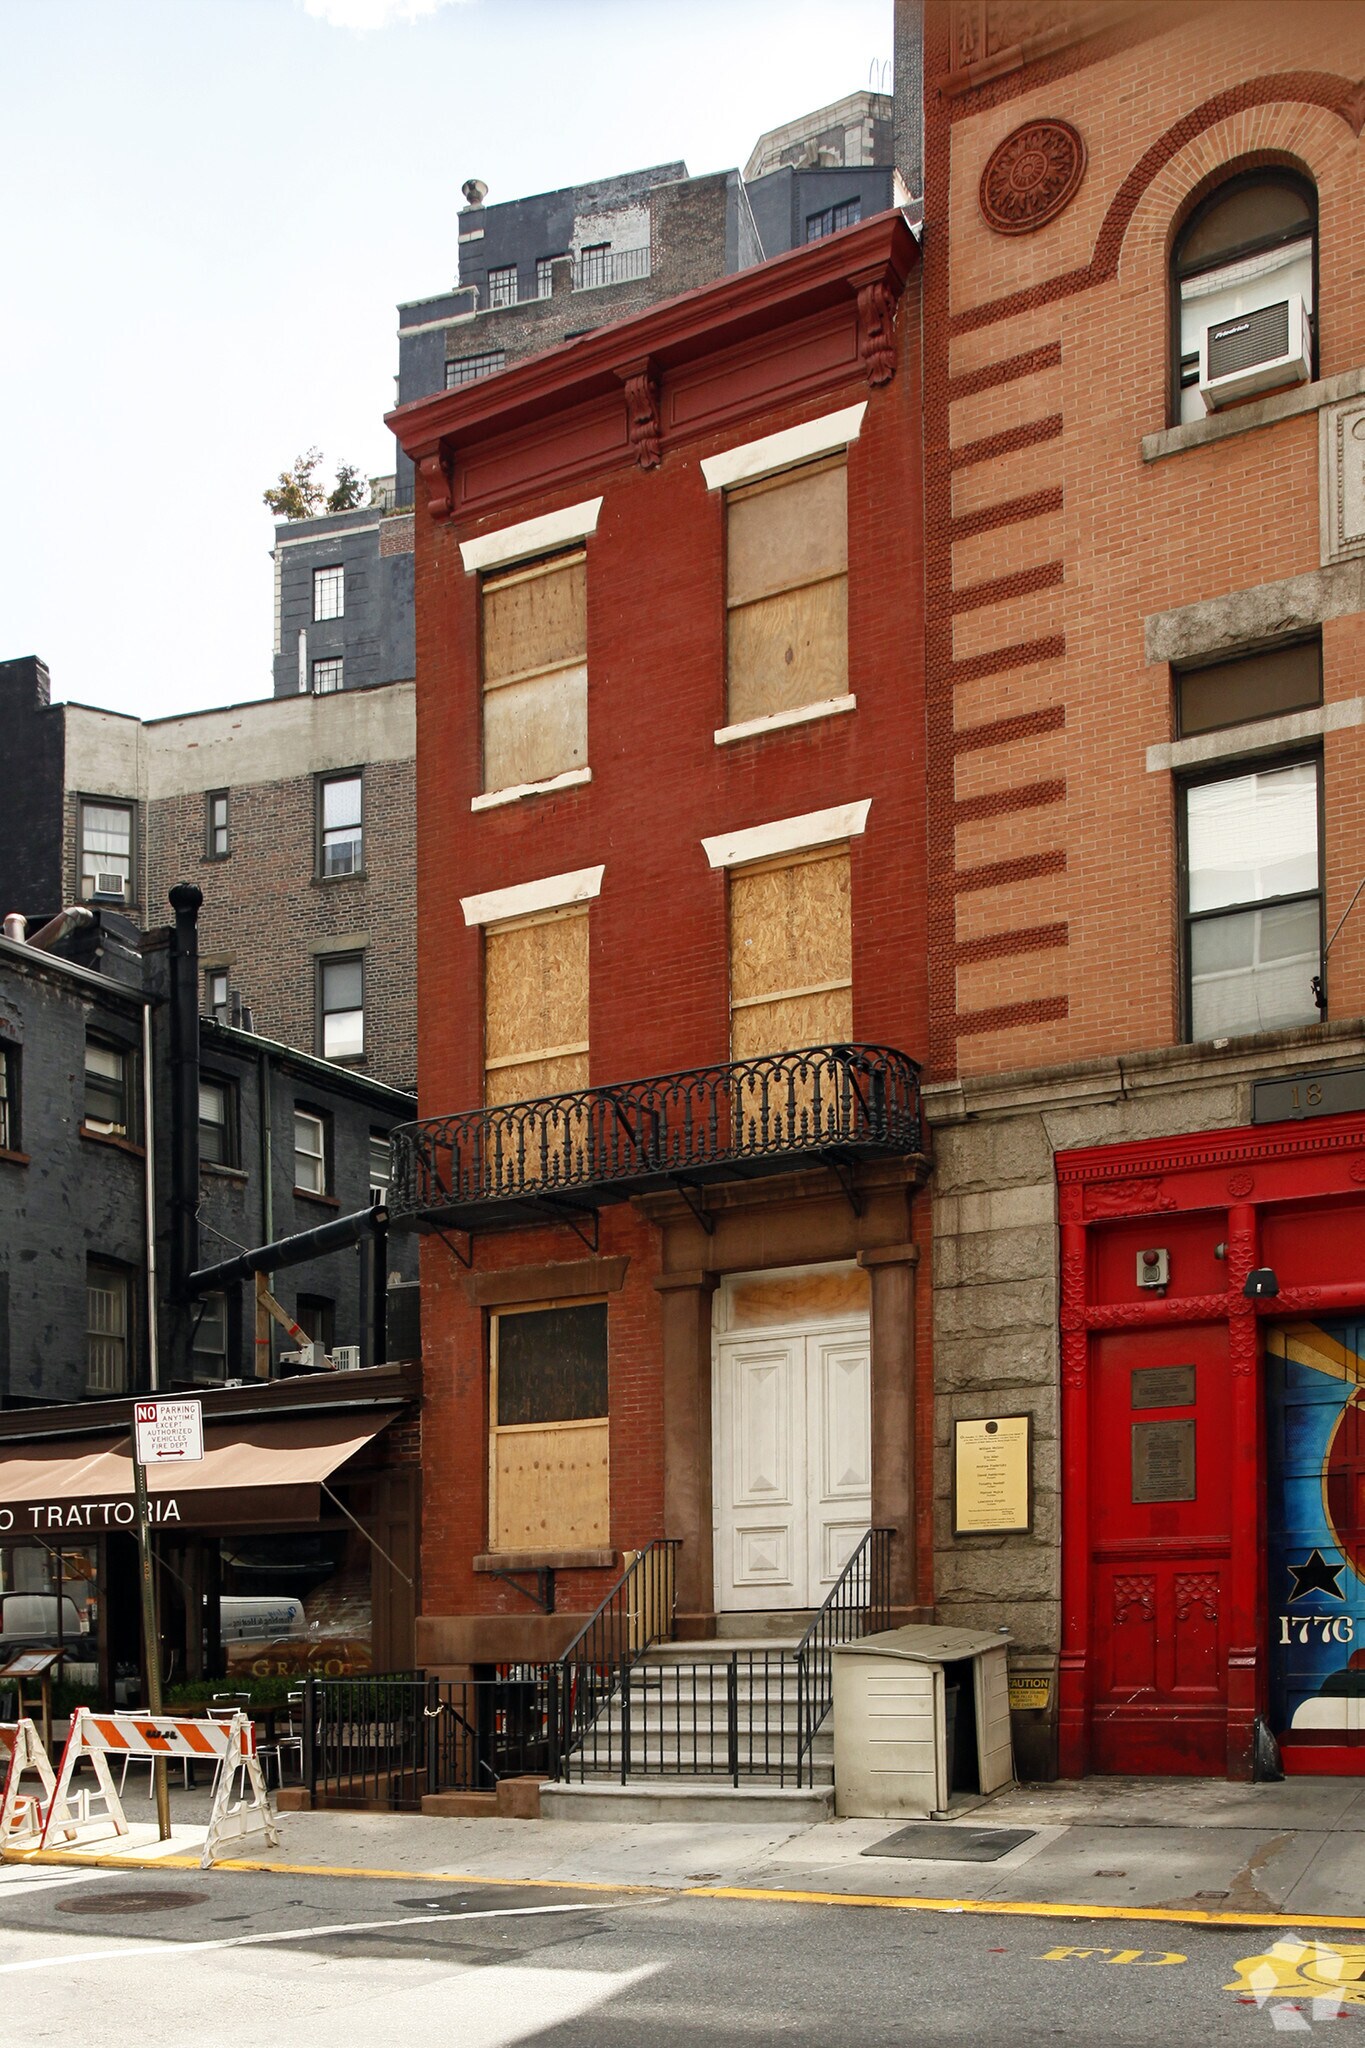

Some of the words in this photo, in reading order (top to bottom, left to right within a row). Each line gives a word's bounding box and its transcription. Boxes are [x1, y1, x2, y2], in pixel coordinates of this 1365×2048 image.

[1291, 1084, 1322, 1109] 18
[138, 1406, 156, 1421] NO
[160, 1405, 196, 1414] PARKING
[162, 1414, 195, 1422] ANYTIME
[155, 1421, 182, 1429] EXCEPT
[147, 1428, 193, 1436] AUTHORIZED
[151, 1435, 187, 1443] VEHICLES
[151, 1442, 168, 1450] FIRE
[169, 1441, 188, 1449] DEPT
[1279, 1616, 1354, 1645] 1776
